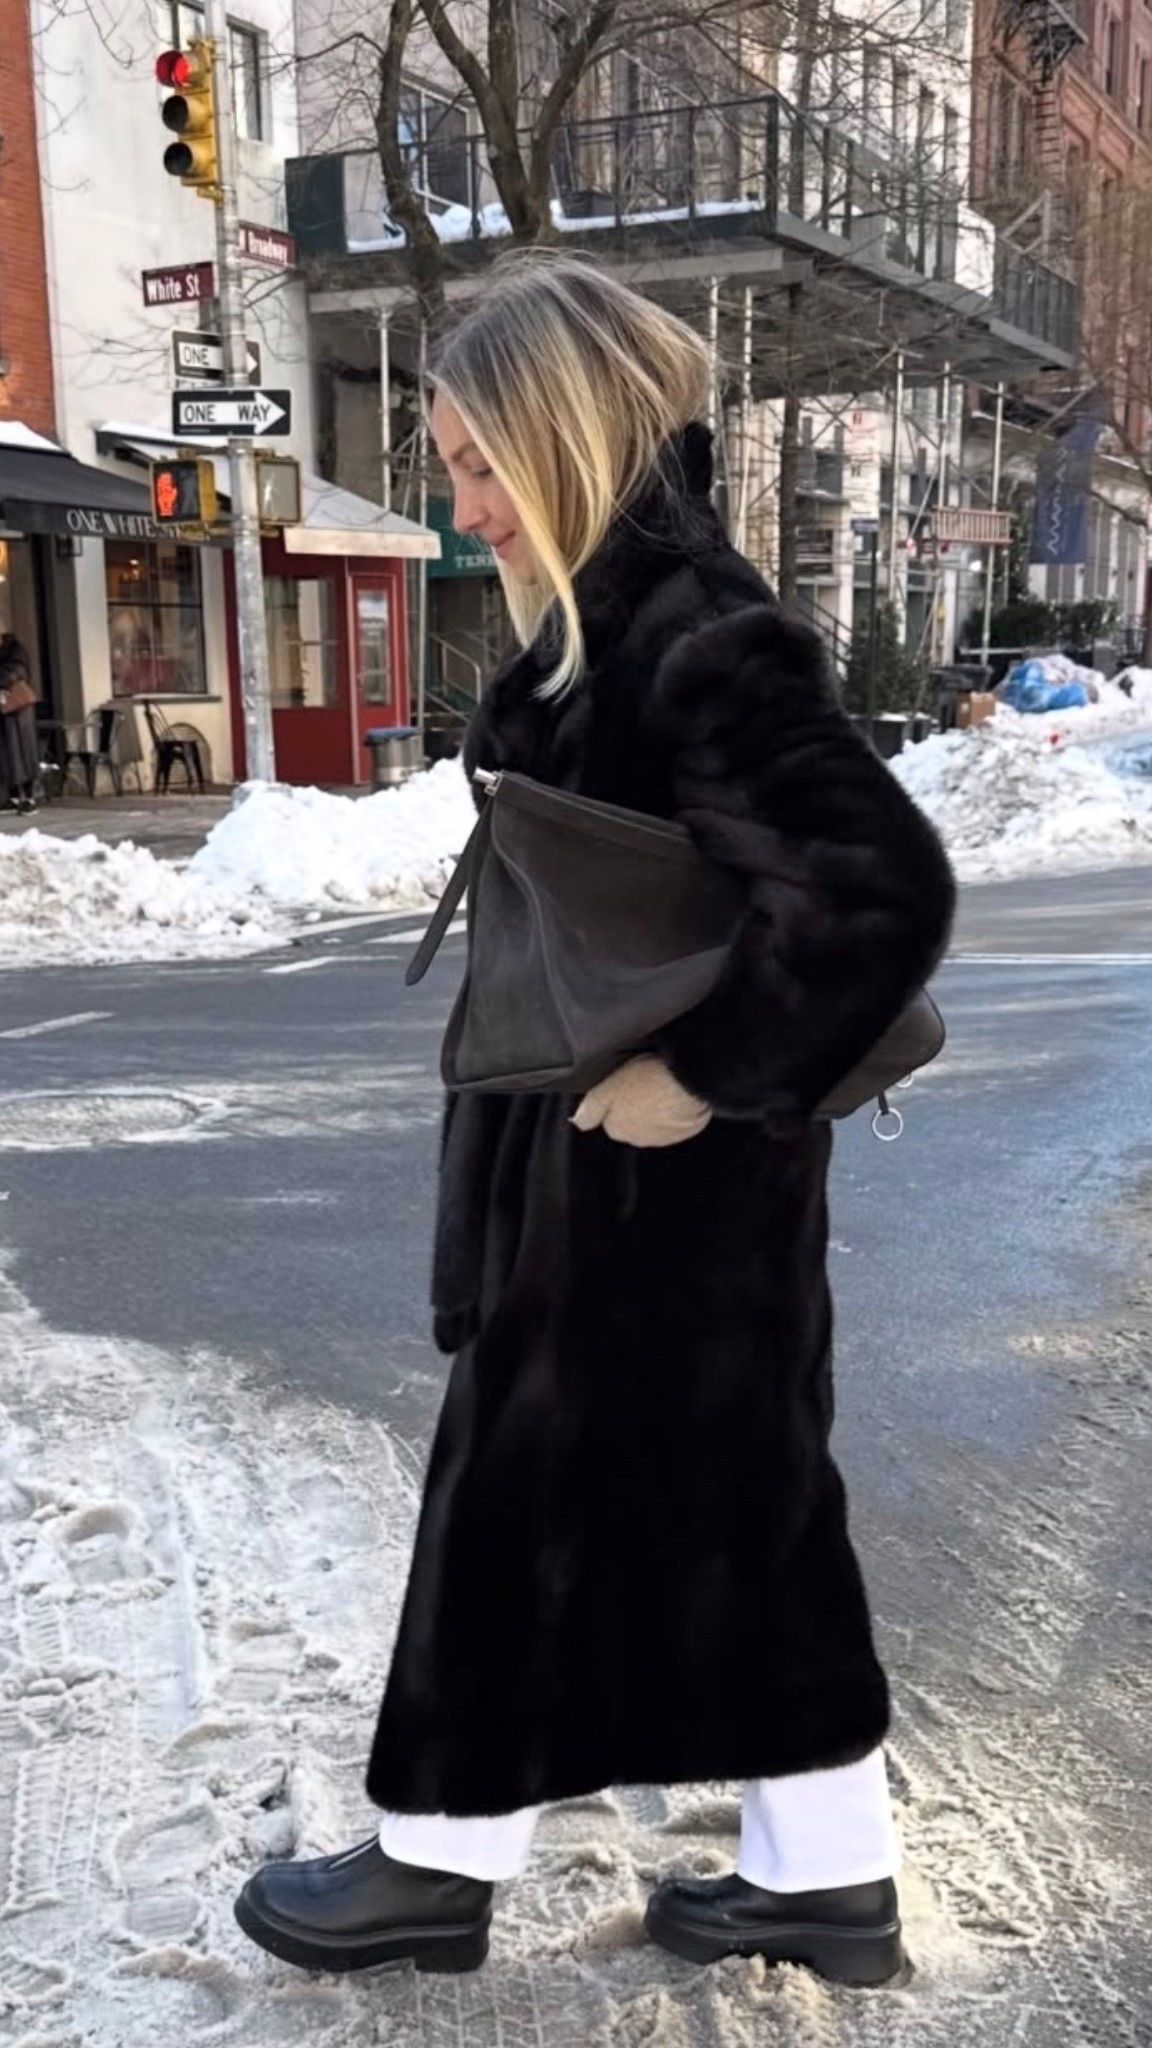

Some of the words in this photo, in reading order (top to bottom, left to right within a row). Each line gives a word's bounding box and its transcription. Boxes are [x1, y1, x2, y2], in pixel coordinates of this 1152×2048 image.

[248, 230, 287, 266] Broadway
[145, 276, 182, 302] White
[185, 273, 200, 297] St
[183, 346, 210, 365] ONE
[184, 404, 216, 422] ONE
[238, 404, 271, 422] WAY
[66, 509, 103, 533] ONE
[103, 512, 156, 538] WHITE
